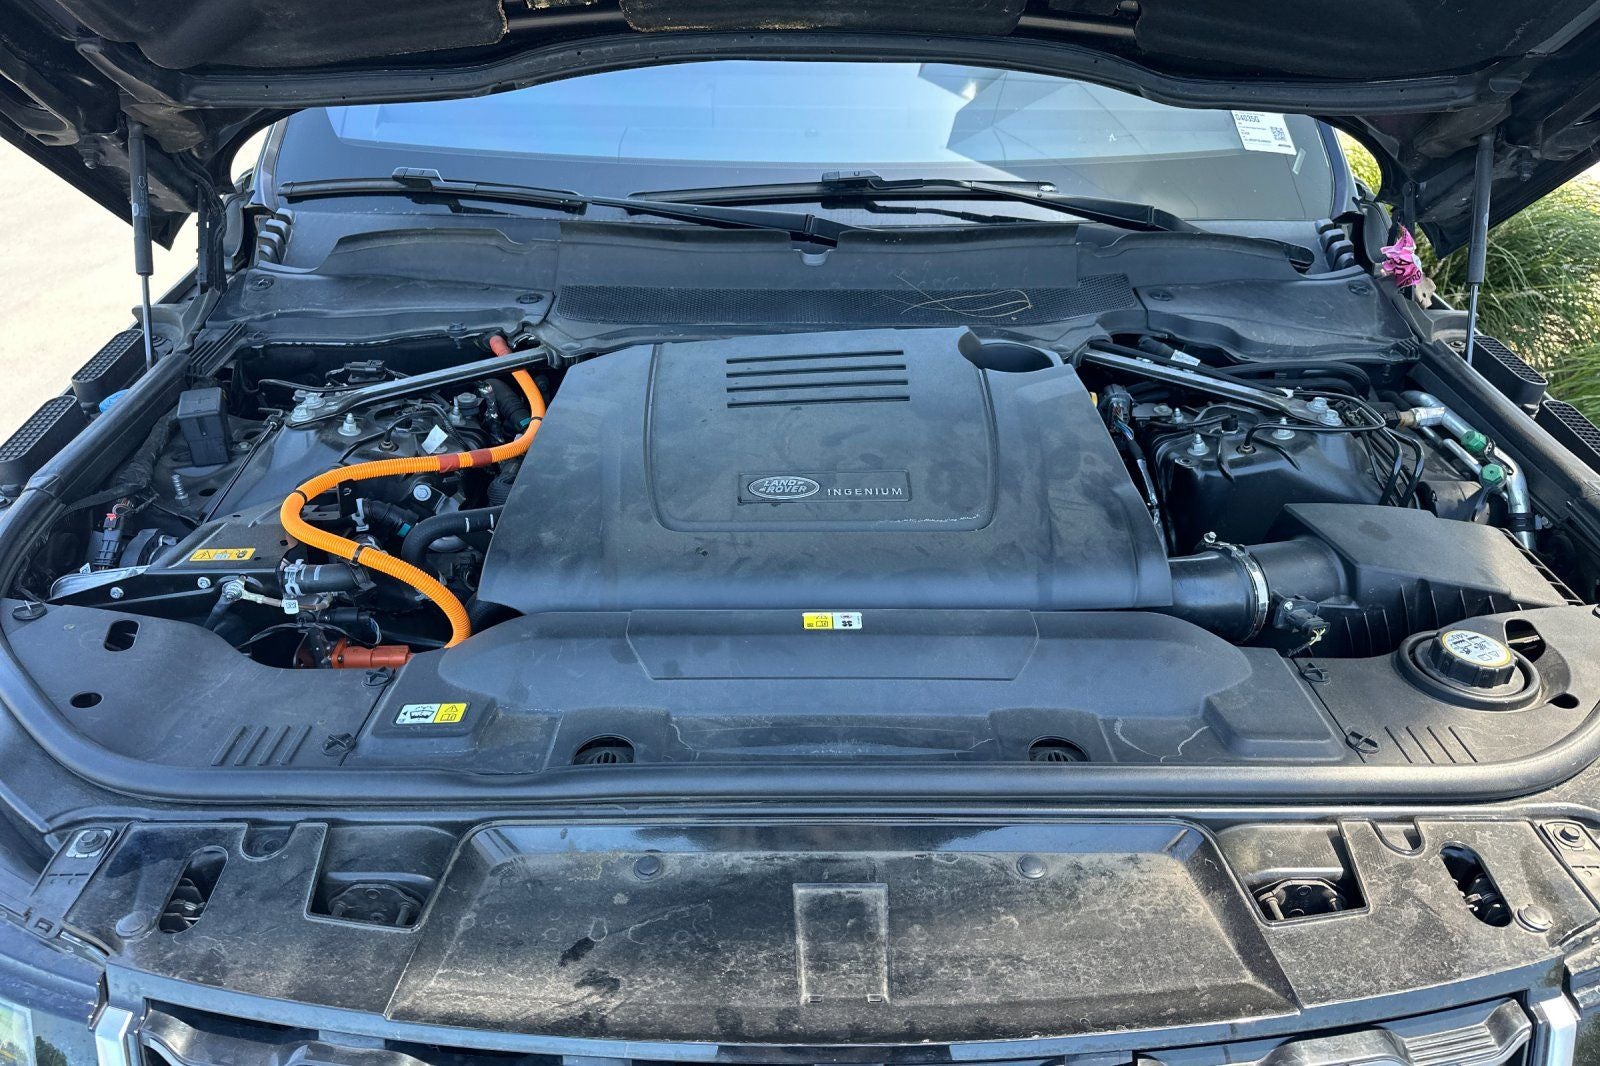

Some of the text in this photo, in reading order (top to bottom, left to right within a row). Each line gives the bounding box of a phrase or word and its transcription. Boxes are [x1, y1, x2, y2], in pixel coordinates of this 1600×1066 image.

[764, 479, 797, 487] LAND
[765, 485, 808, 493] ROVER
[827, 487, 903, 496] INGENIUM
